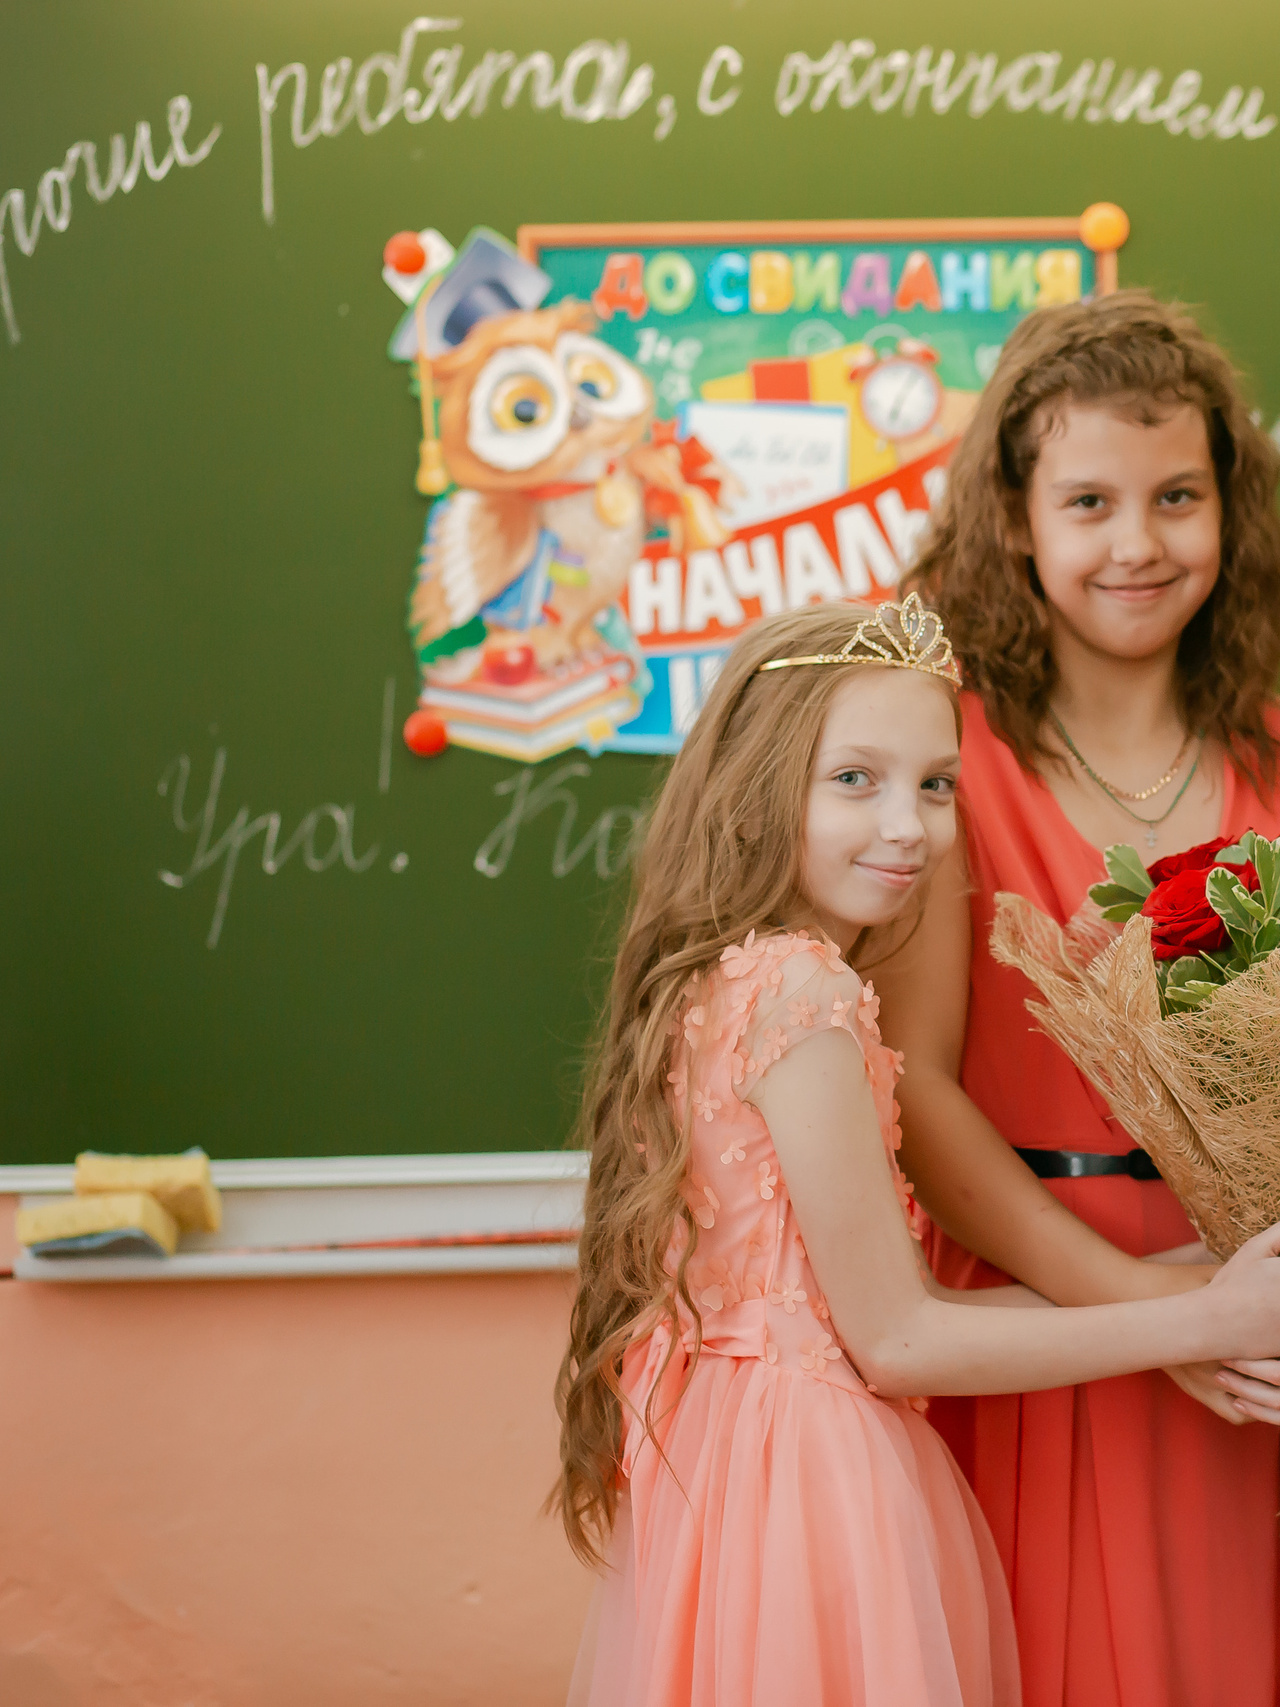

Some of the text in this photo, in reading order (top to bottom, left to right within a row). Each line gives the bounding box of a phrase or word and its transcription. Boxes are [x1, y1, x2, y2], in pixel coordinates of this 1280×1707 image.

[256, 16, 678, 226] ребята,
[697, 45, 743, 116] с
[775, 38, 1278, 142] окончанием
[593, 248, 1082, 320] ДО СВИДАНИЯ
